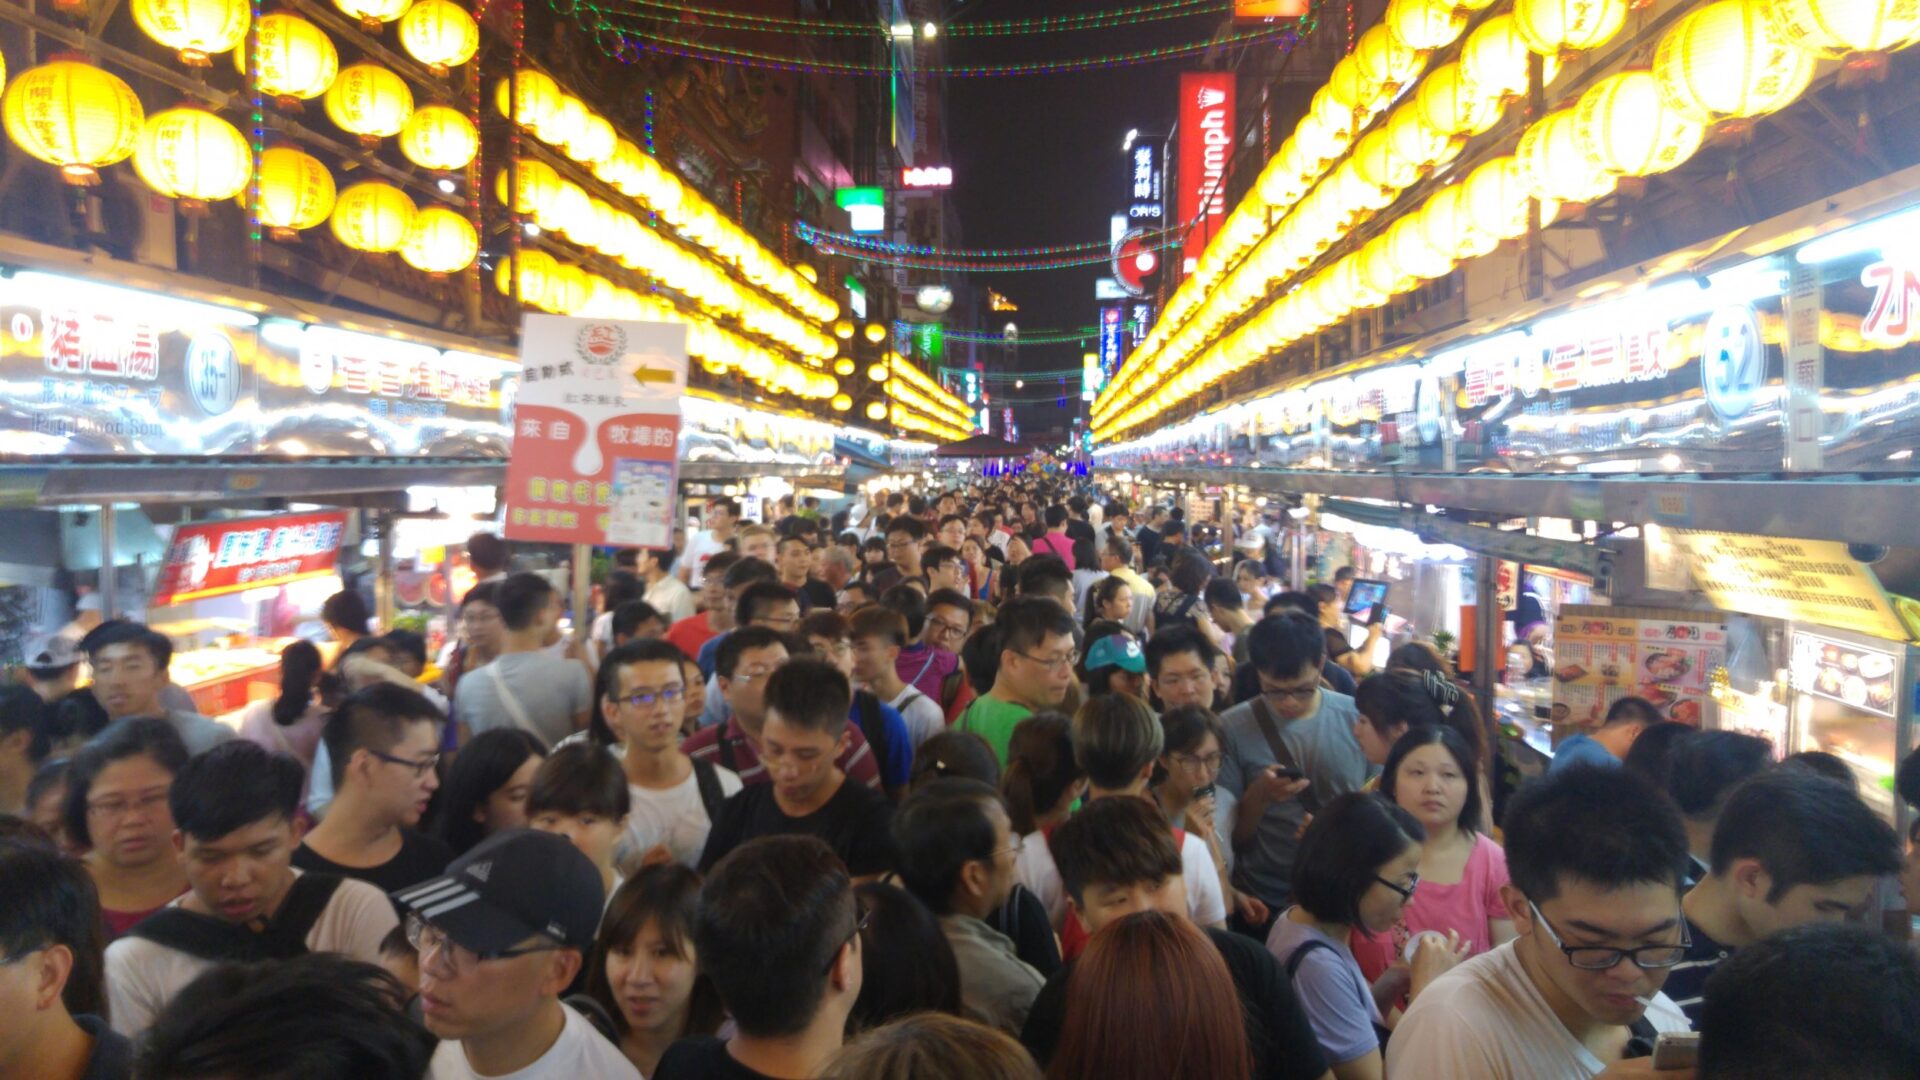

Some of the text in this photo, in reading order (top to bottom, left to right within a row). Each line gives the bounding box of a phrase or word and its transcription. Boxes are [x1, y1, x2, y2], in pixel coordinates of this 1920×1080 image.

[1198, 109, 1231, 222] Triumph
[519, 418, 674, 448] 來自 牧場的
